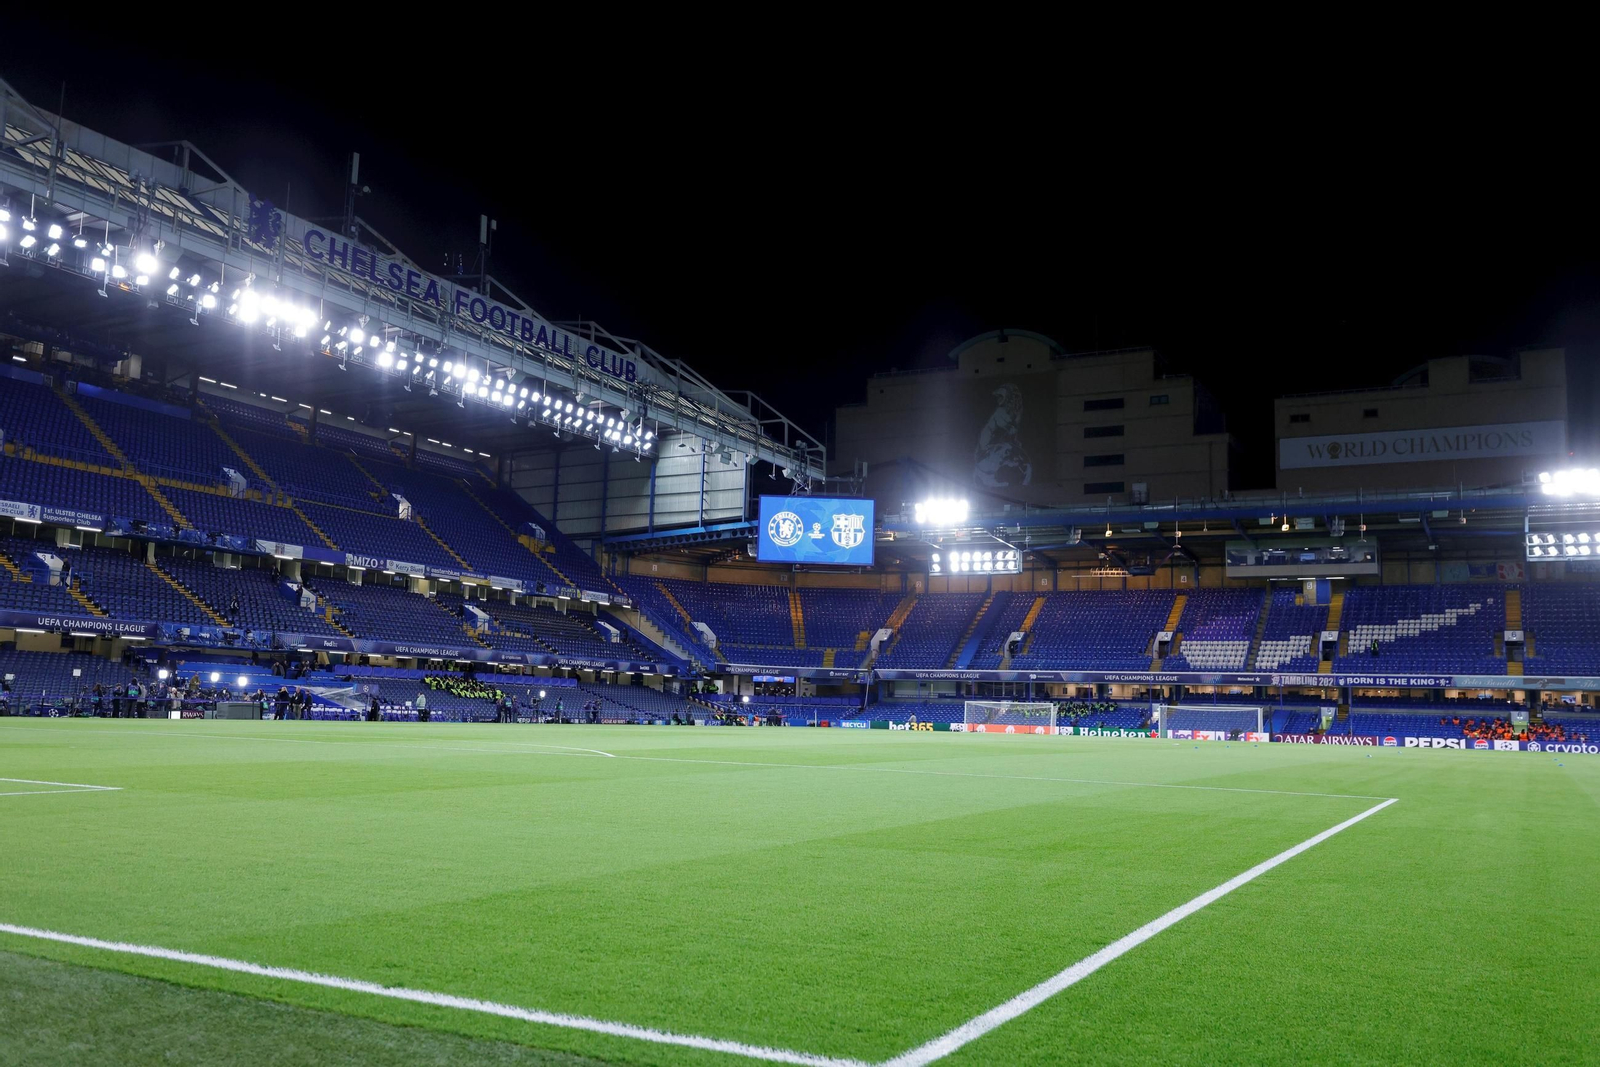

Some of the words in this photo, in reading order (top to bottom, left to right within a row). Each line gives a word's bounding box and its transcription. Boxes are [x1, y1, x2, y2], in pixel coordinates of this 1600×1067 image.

[303, 229, 441, 307] CHELSEA
[455, 289, 575, 359] FOOTBALL
[585, 345, 638, 384] CLUB
[1307, 439, 1387, 460] WORLD
[1392, 430, 1534, 455] CHAMPIONS
[42, 513, 75, 524] Supporters
[55, 508, 75, 517] ULSTER
[76, 512, 102, 521] CHELSEA
[353, 556, 378, 568] MIZO
[38, 618, 60, 626] UEFA
[63, 619, 113, 630] CHAMPIONS
[115, 623, 145, 633] LEAGUE
[410, 647, 439, 655] CHAMPIONS
[1281, 676, 1317, 686] TAMBLING
[889, 721, 934, 731] bet365
[1079, 728, 1146, 738] Heineken
[1320, 736, 1372, 746] AIRWAYS
[1404, 737, 1465, 749] PEPSI
